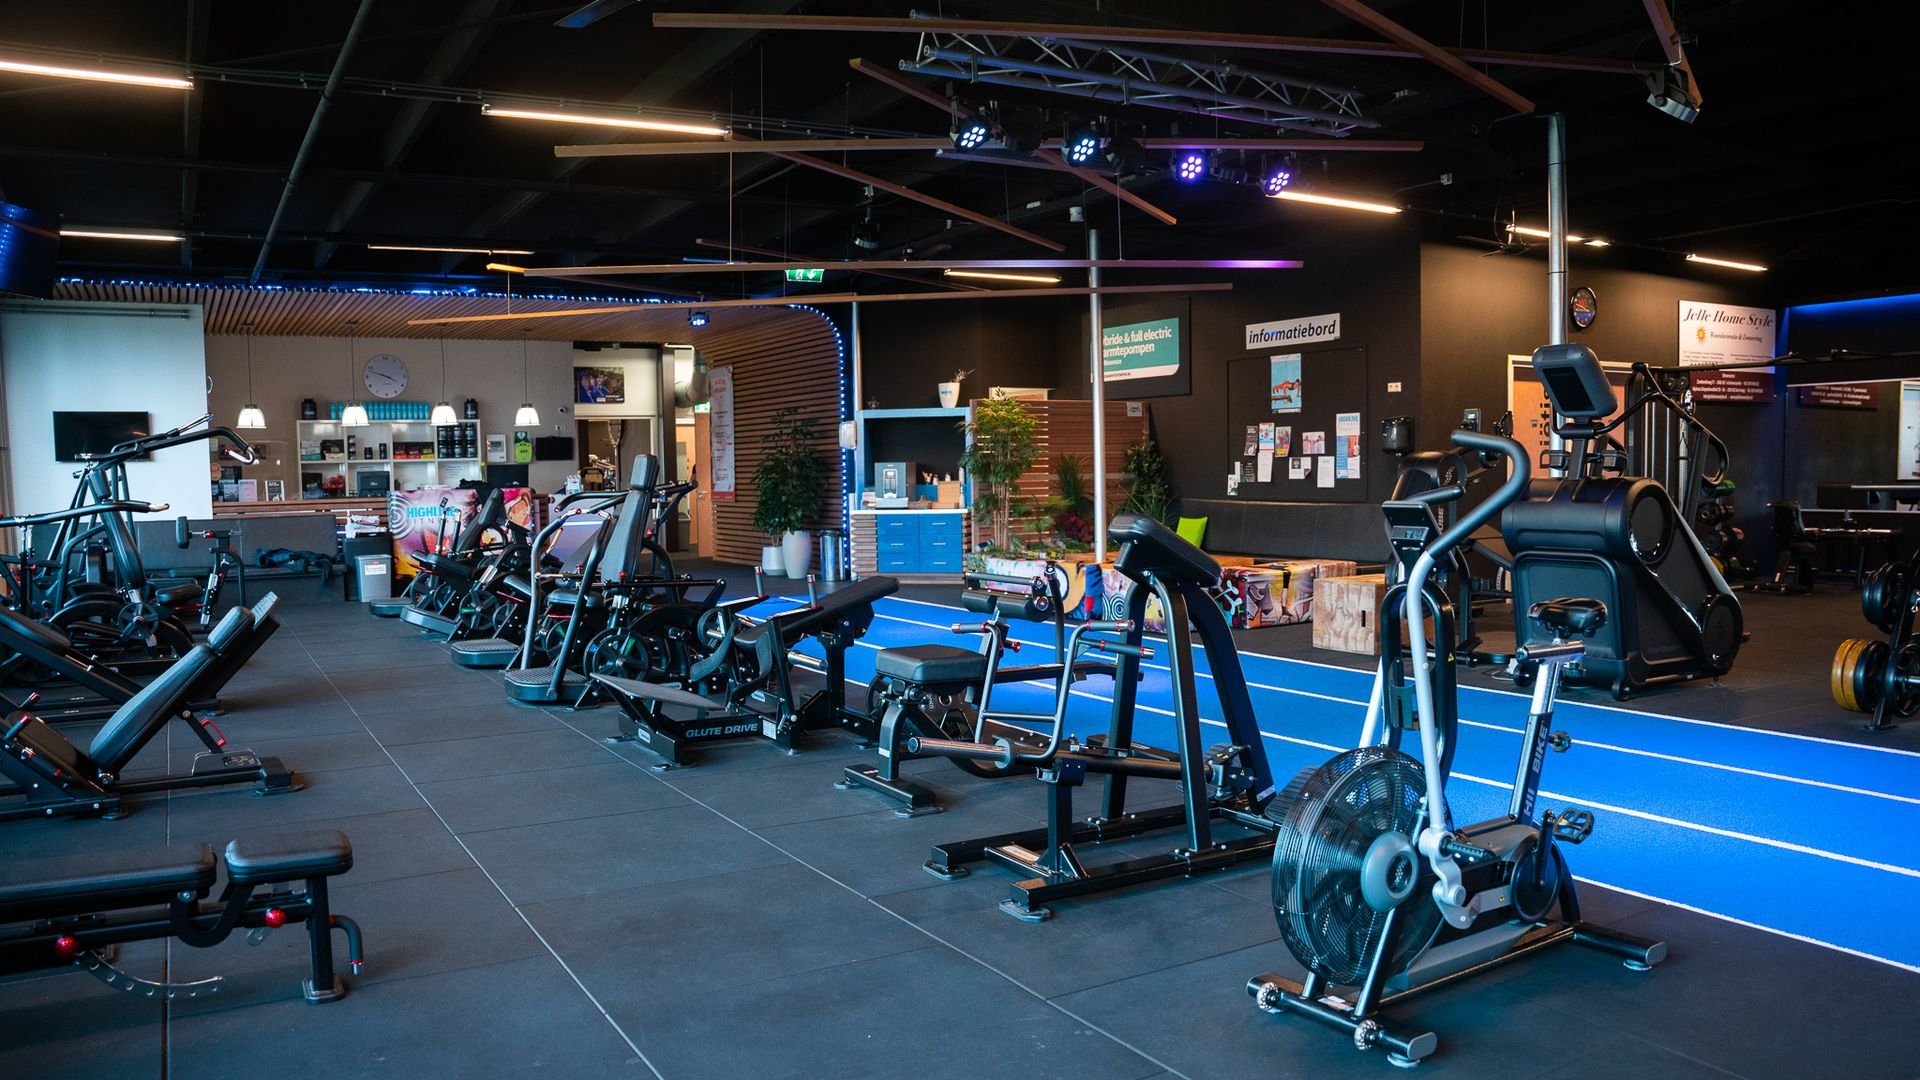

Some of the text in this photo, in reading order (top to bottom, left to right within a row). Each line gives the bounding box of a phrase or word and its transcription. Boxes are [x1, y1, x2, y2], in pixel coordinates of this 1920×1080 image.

[1683, 308, 1774, 330] Jelle Home Style
[1123, 332, 1130, 344] &
[1130, 330, 1143, 343] full
[1143, 326, 1172, 341] electric
[1249, 320, 1335, 344] informatiebord
[1103, 343, 1154, 358] armtepompen
[686, 723, 758, 738] GLUTE DRIVE
[1532, 724, 1547, 774] BIKE
